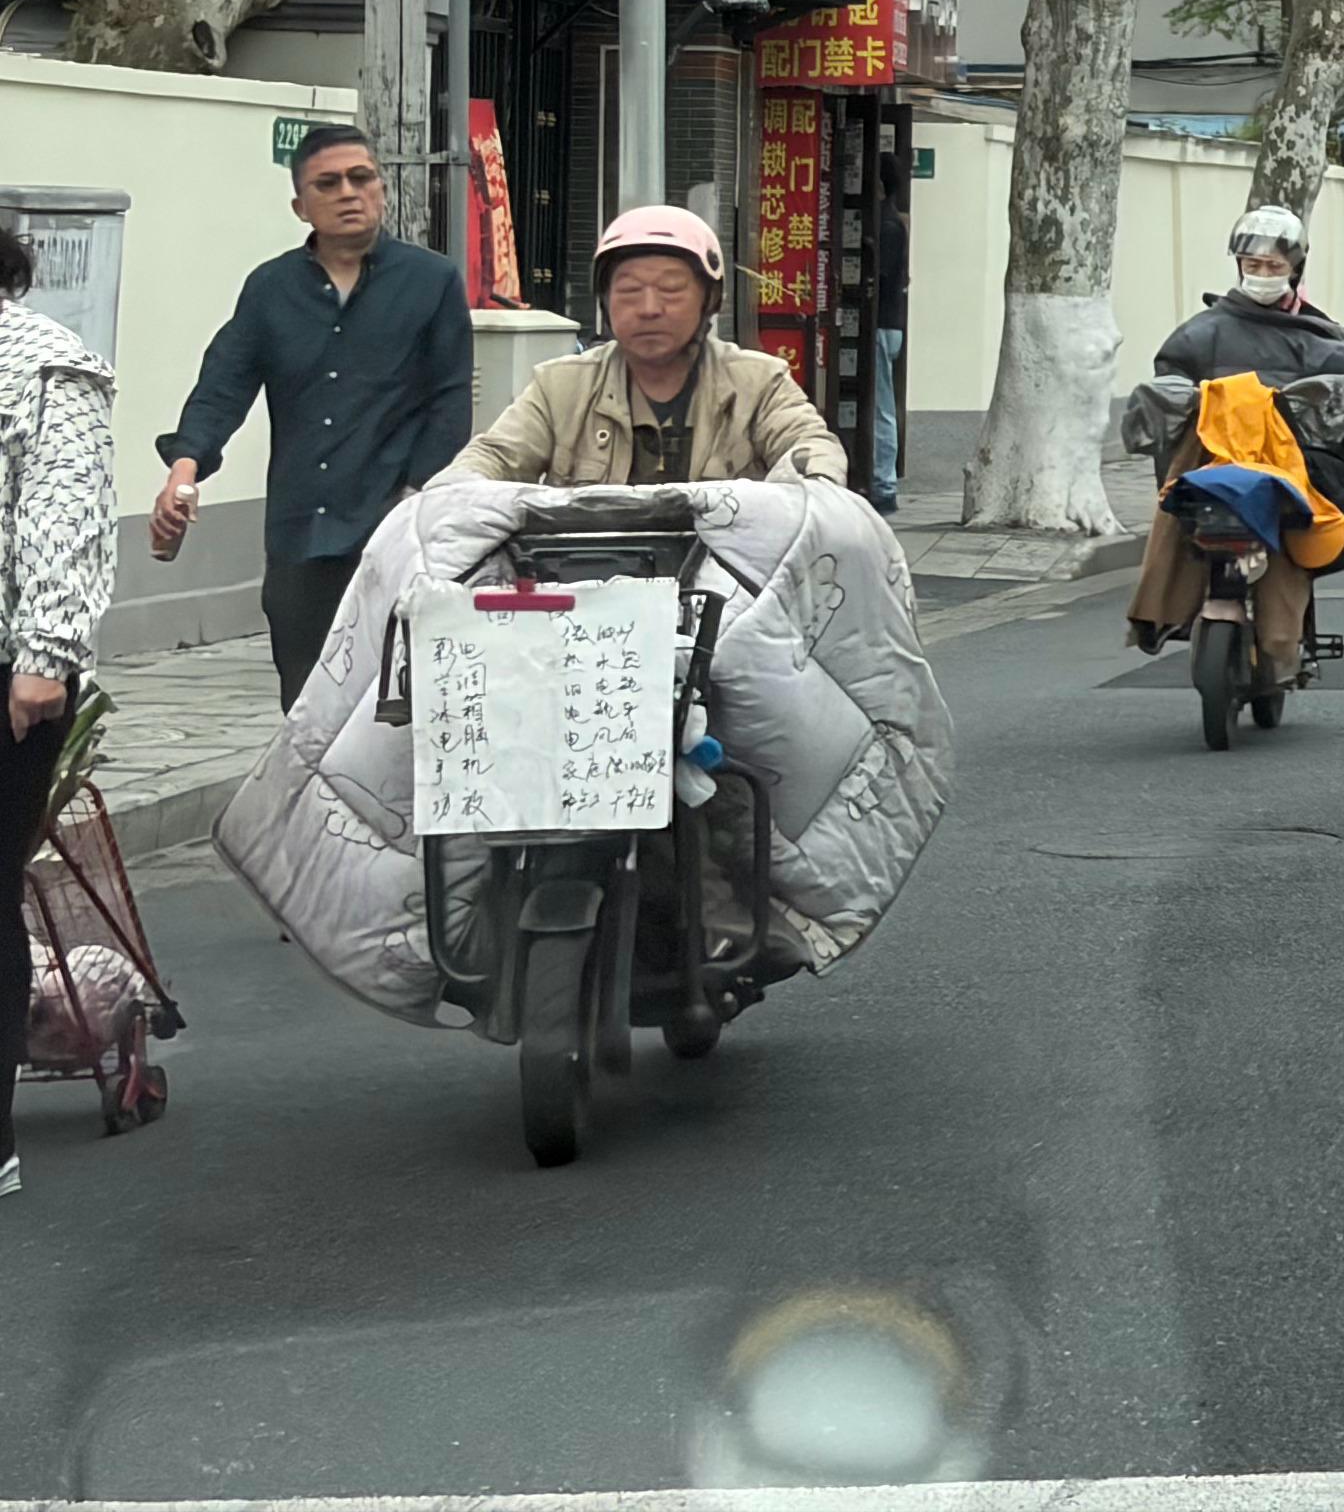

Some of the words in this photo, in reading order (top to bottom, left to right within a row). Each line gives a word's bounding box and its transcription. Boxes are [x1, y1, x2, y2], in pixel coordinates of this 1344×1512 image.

[761, 36, 886, 79] 配门禁卡
[760, 99, 788, 306] 调锁芯修锁
[429, 692, 485, 727] 冰箱
[429, 724, 490, 755] 电脑
[431, 758, 495, 786] 手机
